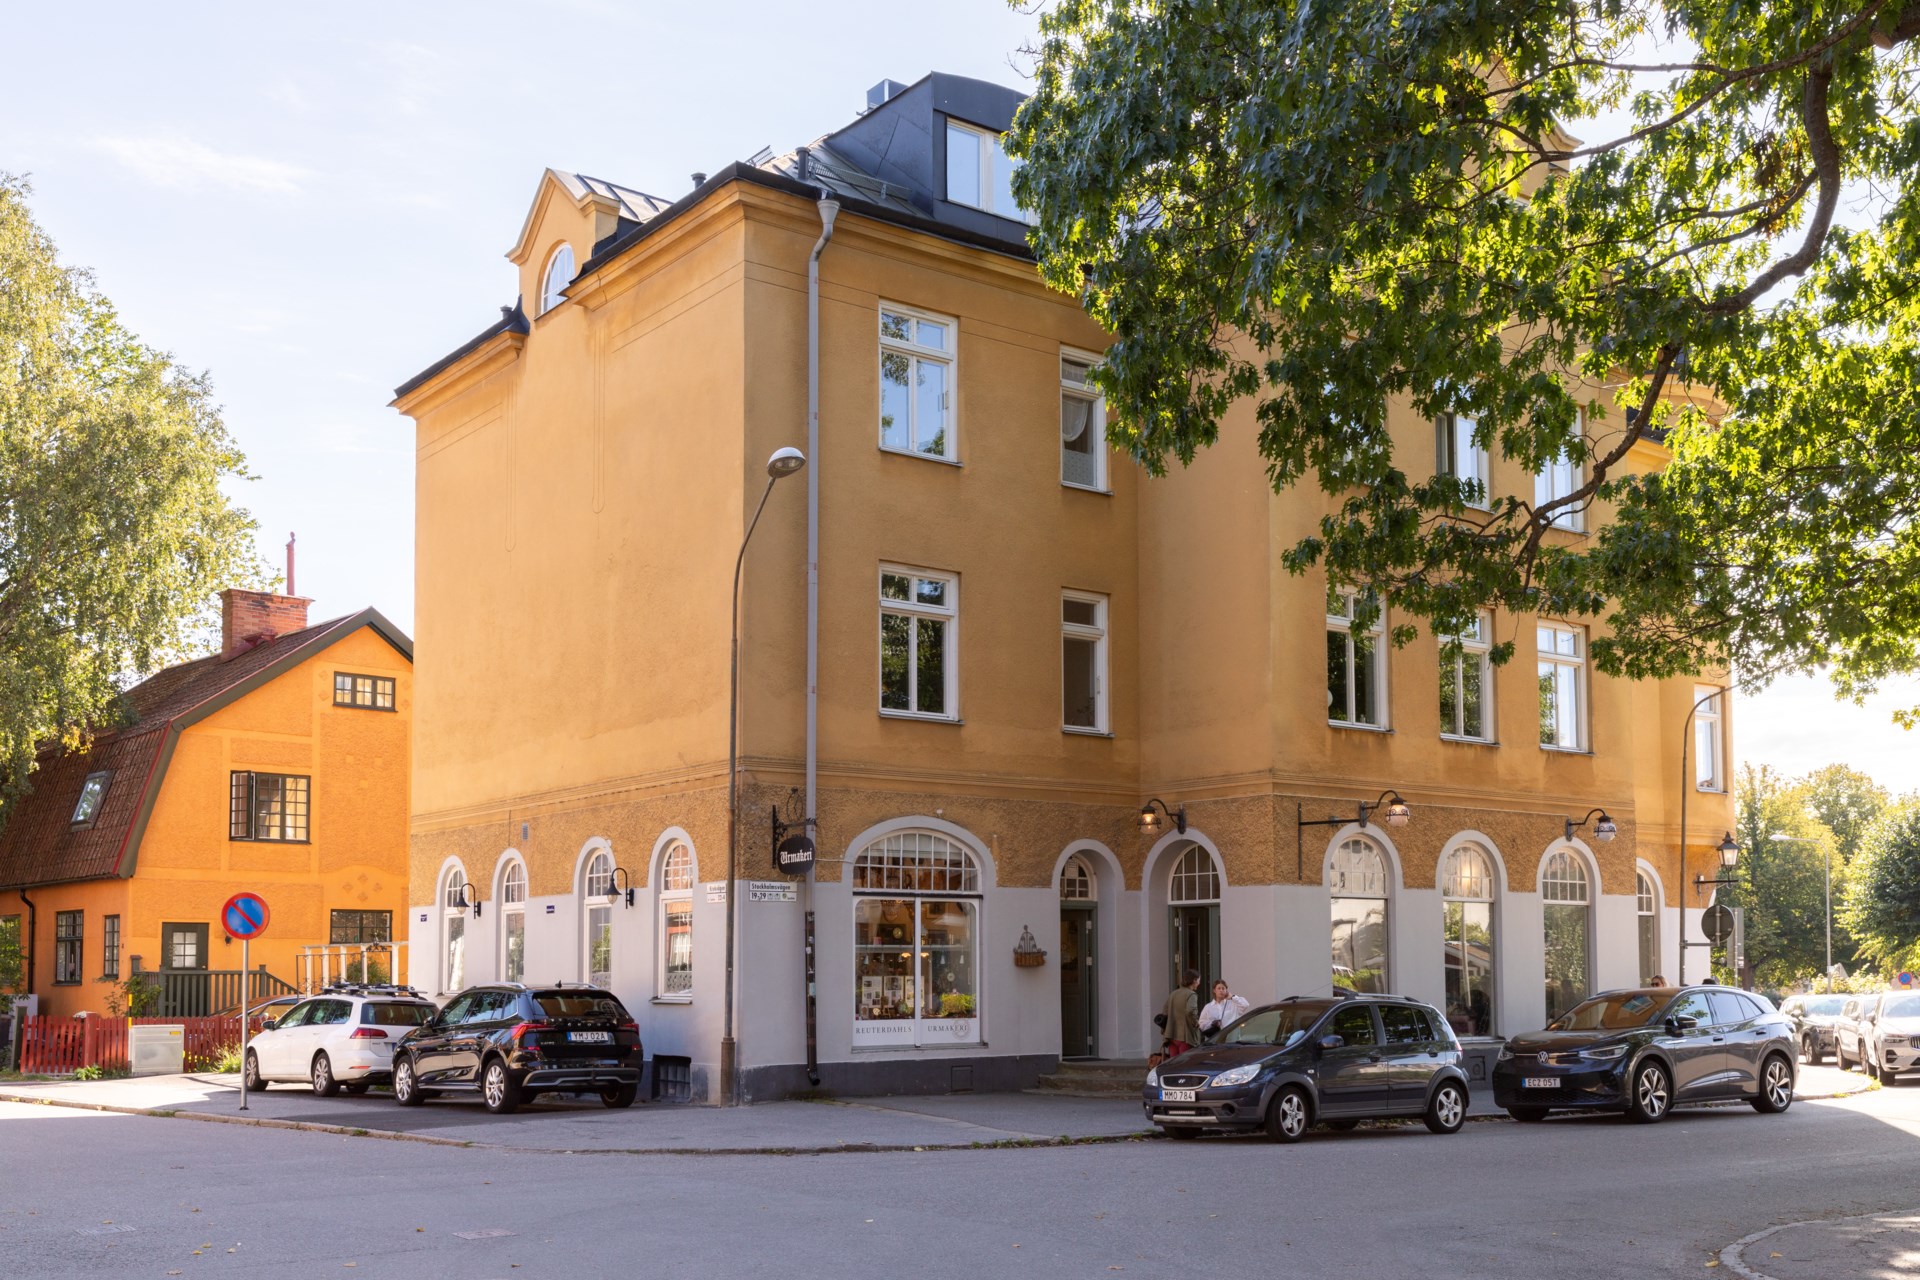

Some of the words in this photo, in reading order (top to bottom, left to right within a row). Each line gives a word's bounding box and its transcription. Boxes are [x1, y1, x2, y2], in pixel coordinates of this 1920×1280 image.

[780, 848, 812, 864] Urmakeri
[751, 882, 791, 892] Stockholmsvägen
[855, 1025, 912, 1034] REUTERDAHLS
[574, 1032, 589, 1040] YMJ
[590, 1032, 606, 1040] 02A
[1527, 1078, 1541, 1087] ECZ
[1179, 1091, 1193, 1100] 784
